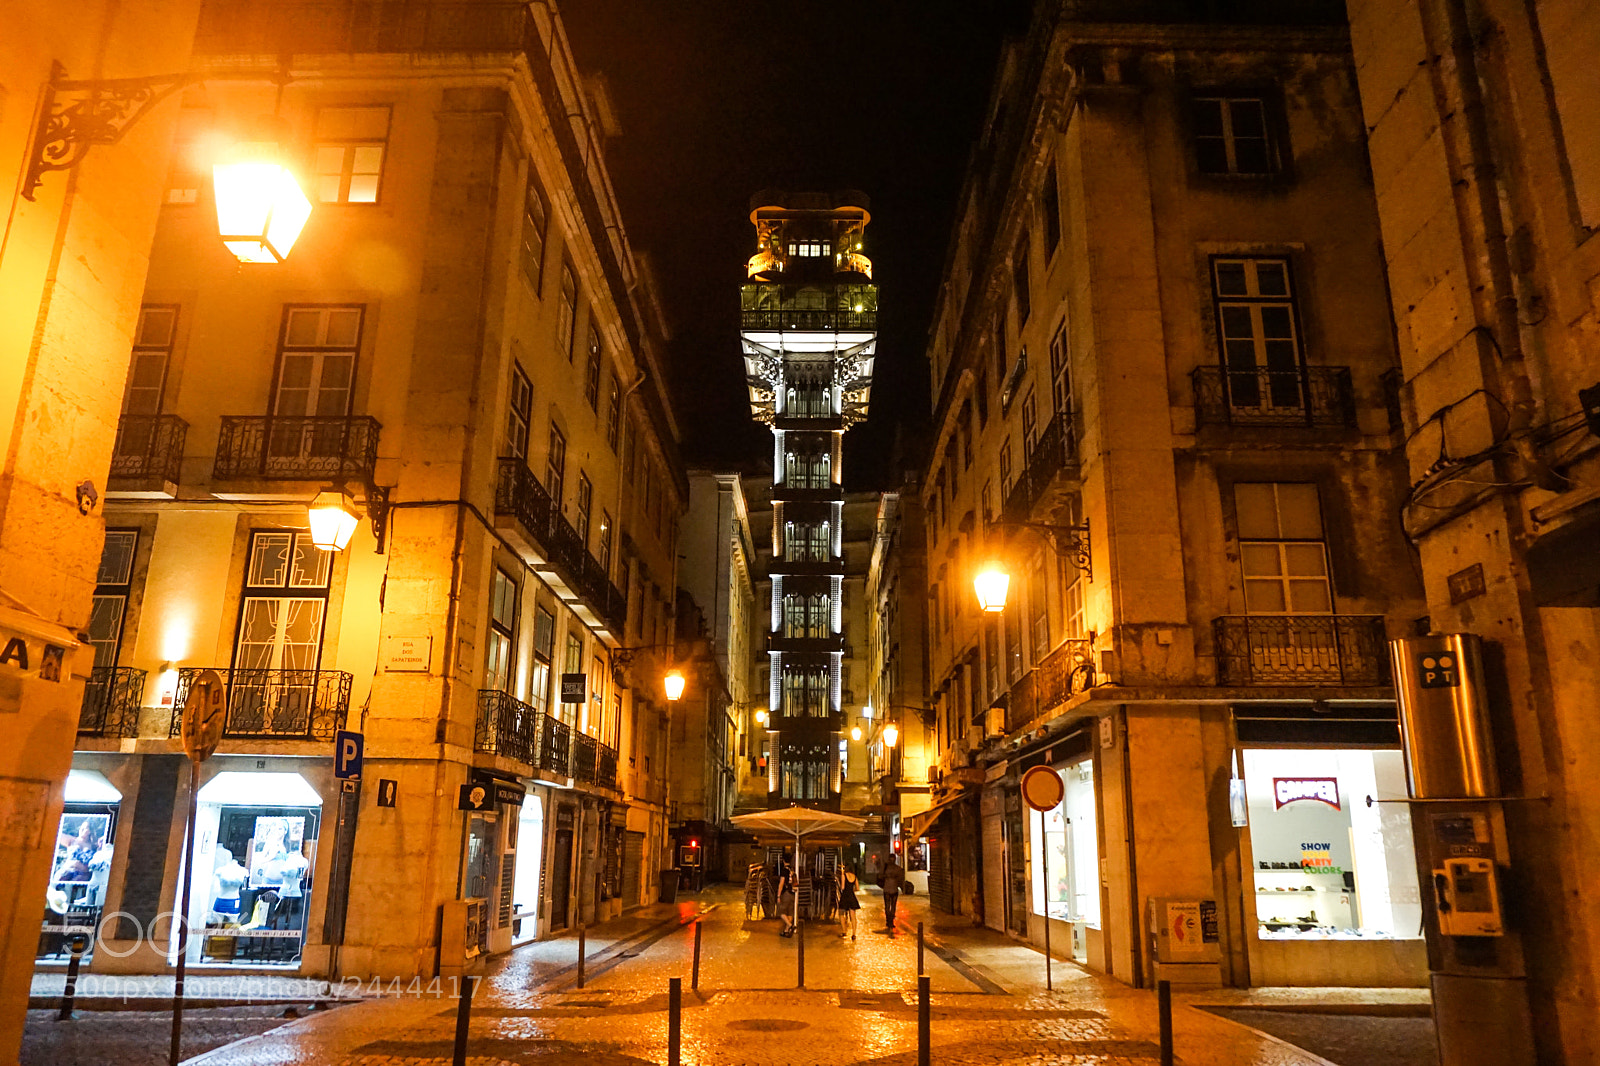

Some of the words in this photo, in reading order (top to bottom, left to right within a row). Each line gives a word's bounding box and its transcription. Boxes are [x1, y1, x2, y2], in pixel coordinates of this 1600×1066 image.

[342, 738, 358, 771] P
[1301, 842, 1331, 851] SHOW
[1302, 851, 1330, 859] YOUR
[1302, 858, 1333, 867] PARTY
